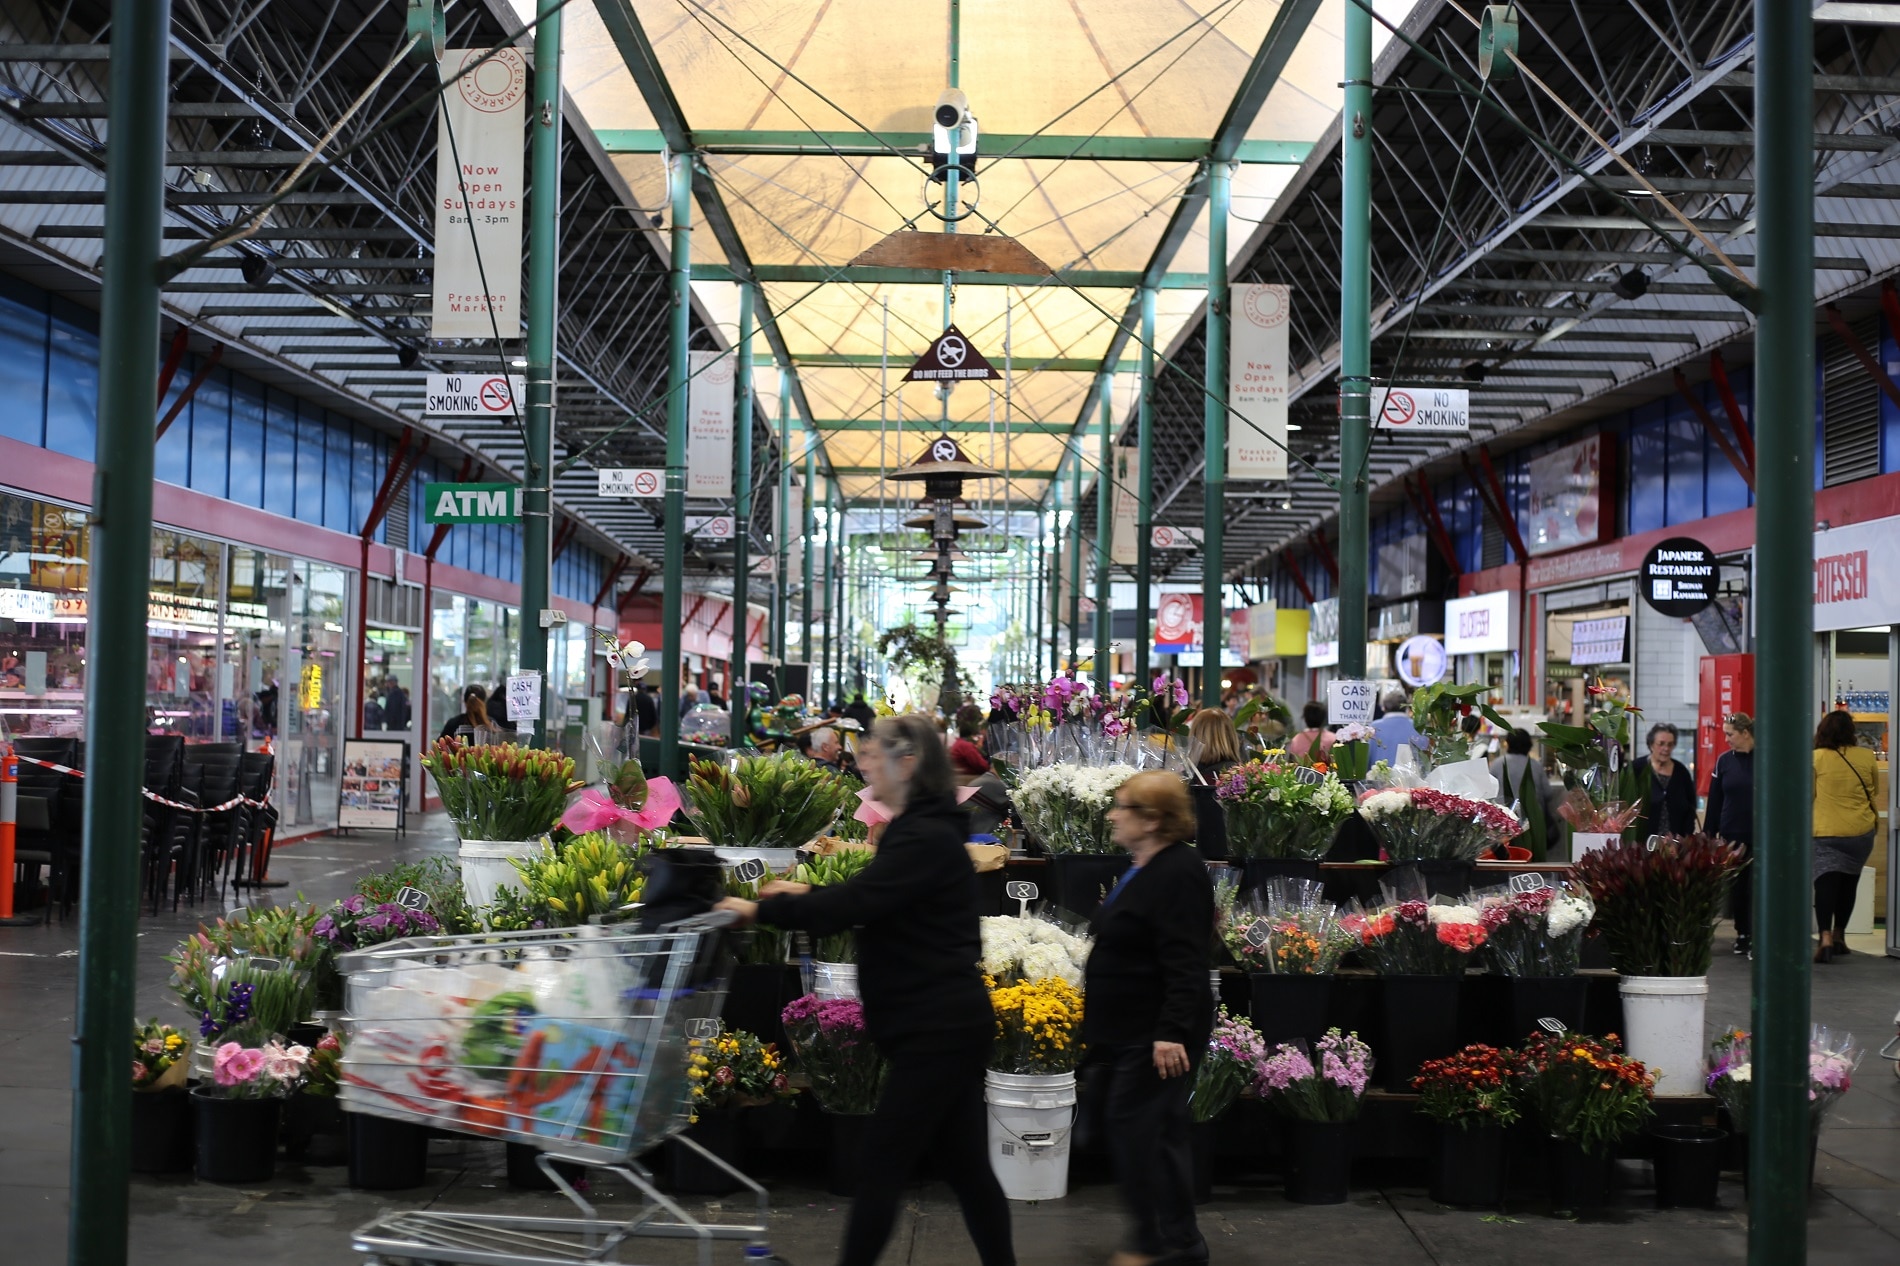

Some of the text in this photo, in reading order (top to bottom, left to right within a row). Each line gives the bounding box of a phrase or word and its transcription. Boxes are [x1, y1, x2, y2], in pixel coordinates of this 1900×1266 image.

[484, 49, 524, 85] POPLE'S
[467, 90, 516, 108] MARKET
[463, 165, 498, 175] Now
[458, 182, 502, 194] Open
[444, 198, 516, 211] Sundays
[485, 215, 509, 225] 3pm
[448, 293, 506, 302] Preston
[450, 303, 504, 312] Market
[1247, 362, 1272, 370] Now
[913, 368, 989, 379] DO NOT FEED THE BIRDS
[1244, 373, 1275, 382] Open
[446, 377, 462, 393] NO
[1234, 384, 1284, 393] Sundays
[429, 396, 478, 412] SMOKING
[1434, 392, 1449, 408] NO
[1417, 410, 1466, 426] SMOKING
[693, 426, 730, 434] Sundays
[612, 471, 623, 481] NO
[600, 483, 634, 494] SMOKING
[434, 491, 507, 517] ATM
[1657, 549, 1705, 563] JAPANESE
[1649, 564, 1713, 576] RESTAURANT
[1677, 581, 1703, 590] SHONAN
[1673, 591, 1708, 600] KAMAKURA
[511, 681, 532, 692] CASH
[1341, 685, 1370, 696] CASH
[511, 696, 531, 707] ONLY
[1342, 700, 1369, 711] ONLY
[1298, 768, 1317, 786] 10
[740, 861, 759, 882] 10
[1515, 874, 1541, 892] 12
[1017, 883, 1030, 898] 8
[401, 888, 422, 907] 13
[1250, 925, 1265, 941] 8
[693, 1019, 713, 1038] 15
